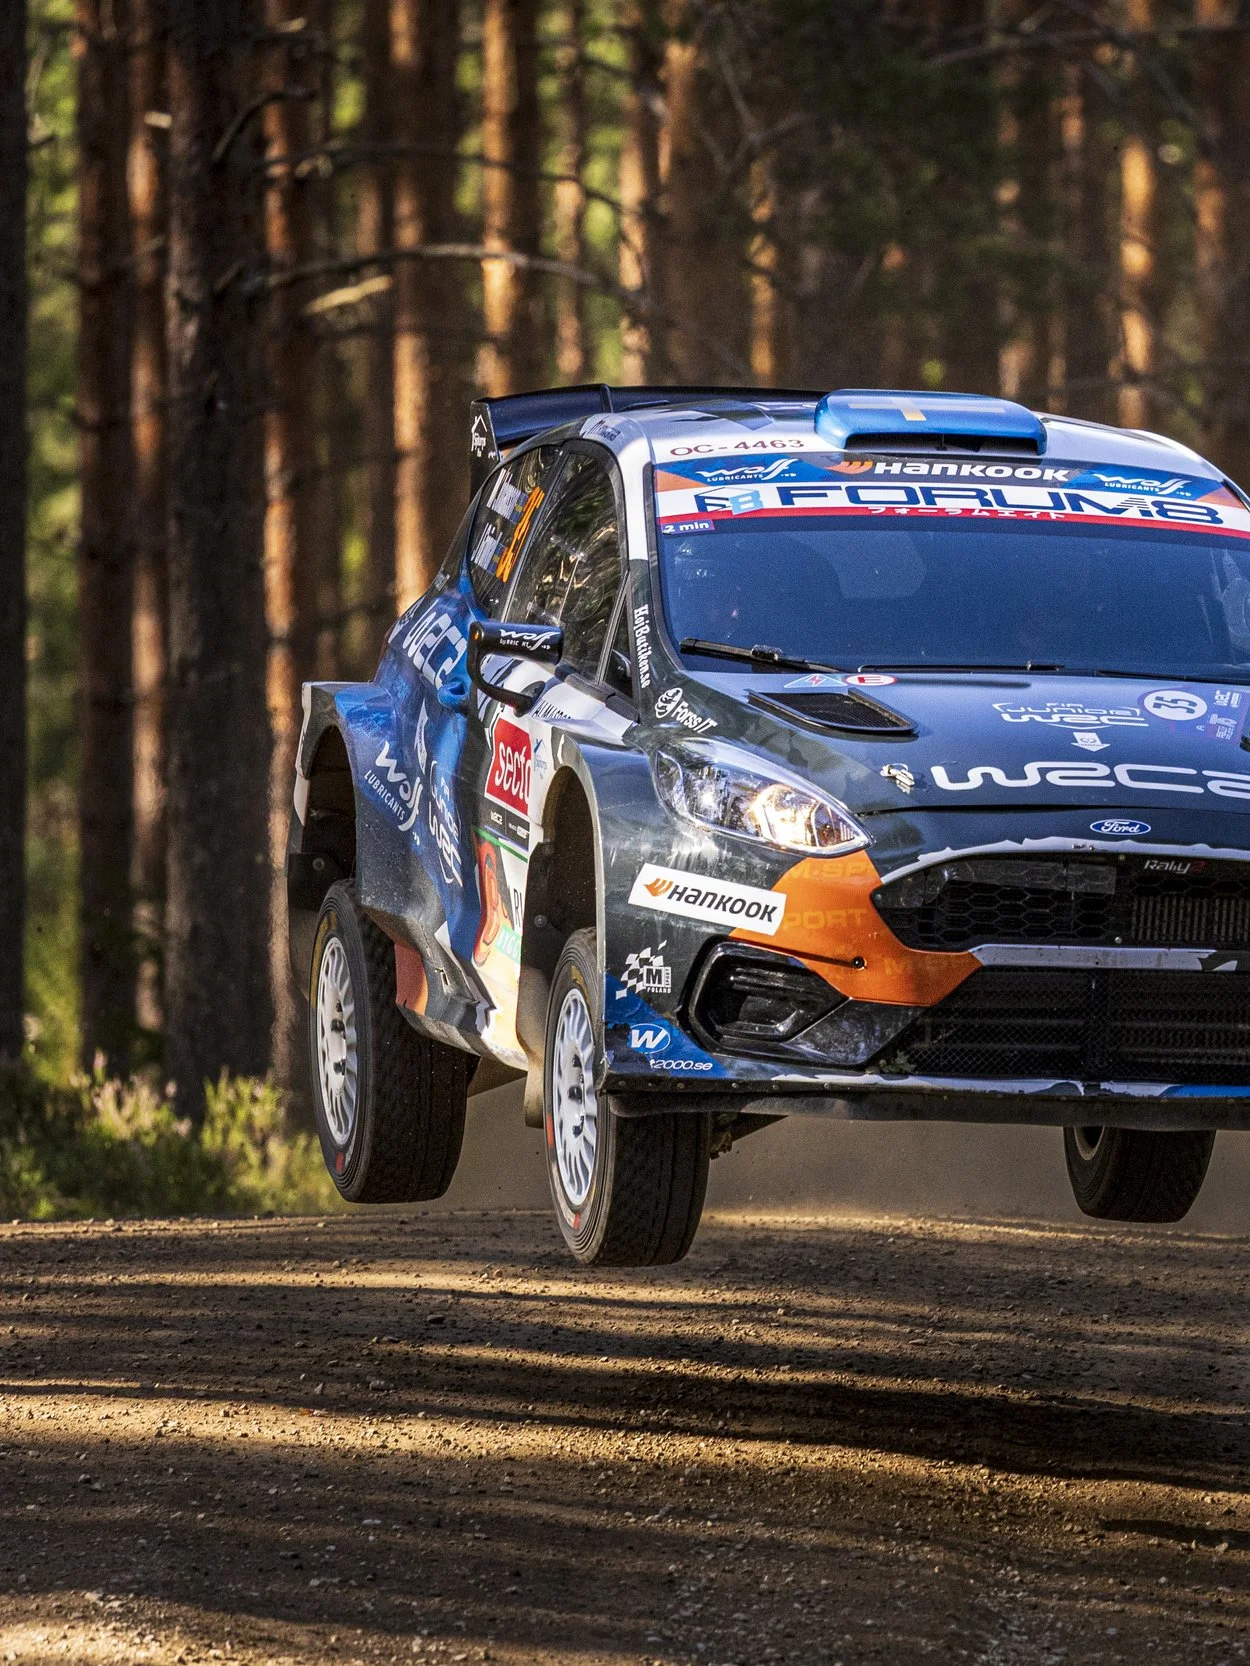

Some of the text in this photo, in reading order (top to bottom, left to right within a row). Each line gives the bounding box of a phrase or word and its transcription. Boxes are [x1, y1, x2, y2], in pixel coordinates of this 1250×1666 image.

[706, 474, 764, 483] LUBRICANTS
[1104, 482, 1160, 493] LUBRICANTS
[776, 484, 1224, 525] FORUM8
[679, 520, 710, 532] min
[1151, 695, 1197, 715] 35
[1000, 713, 1149, 727] WRC
[363, 769, 406, 821] LUBRICANTS
[1101, 820, 1141, 833] Ford
[645, 968, 663, 986] M
[631, 1029, 668, 1049] W
